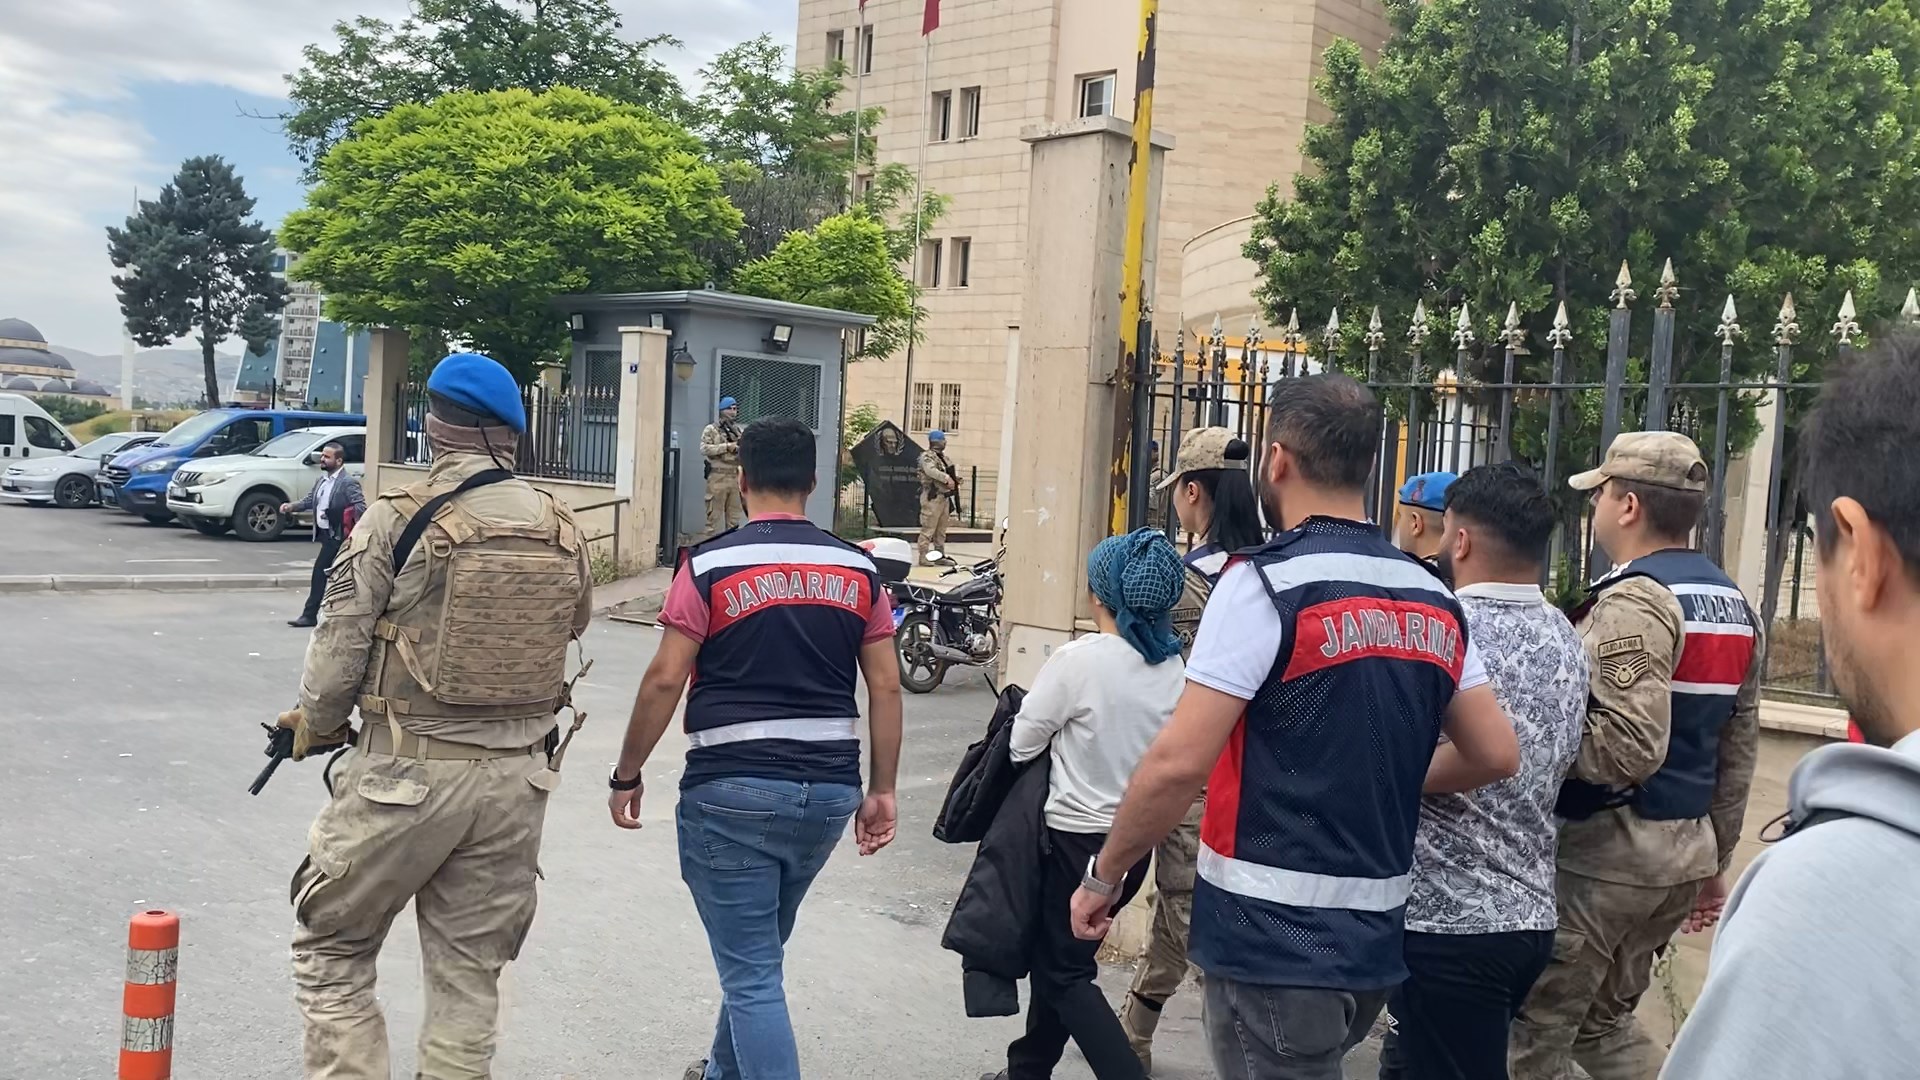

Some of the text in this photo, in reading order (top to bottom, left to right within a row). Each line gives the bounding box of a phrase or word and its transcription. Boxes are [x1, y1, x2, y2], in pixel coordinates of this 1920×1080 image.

[724, 571, 859, 617] JANDARMA
[1320, 608, 1457, 667] JANDARMA
[1602, 639, 1639, 654] JANDARMA
